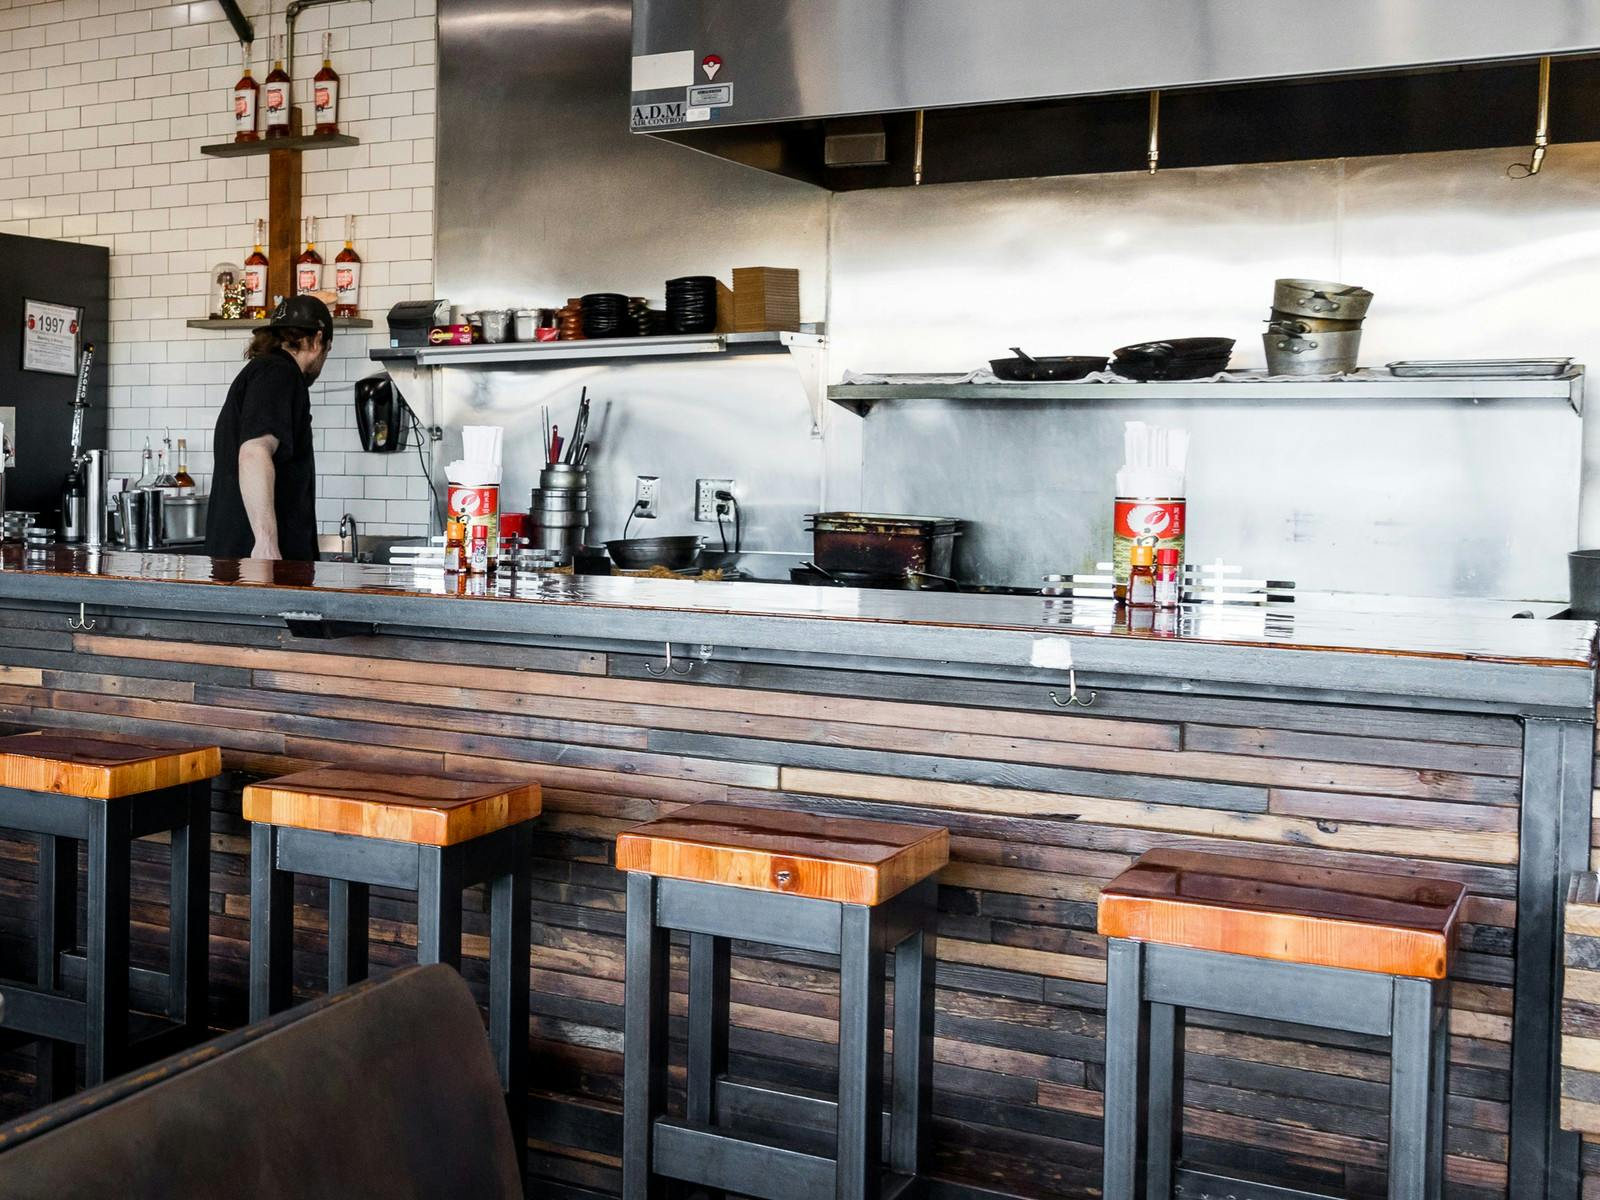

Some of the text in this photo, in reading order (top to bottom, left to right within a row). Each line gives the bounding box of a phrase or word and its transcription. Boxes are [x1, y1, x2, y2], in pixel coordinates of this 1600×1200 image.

[632, 103, 686, 120] A.D.M.
[648, 117, 685, 126] CONTROL
[38, 314, 65, 333] 1997
[81, 352, 93, 398] SAPPORO
